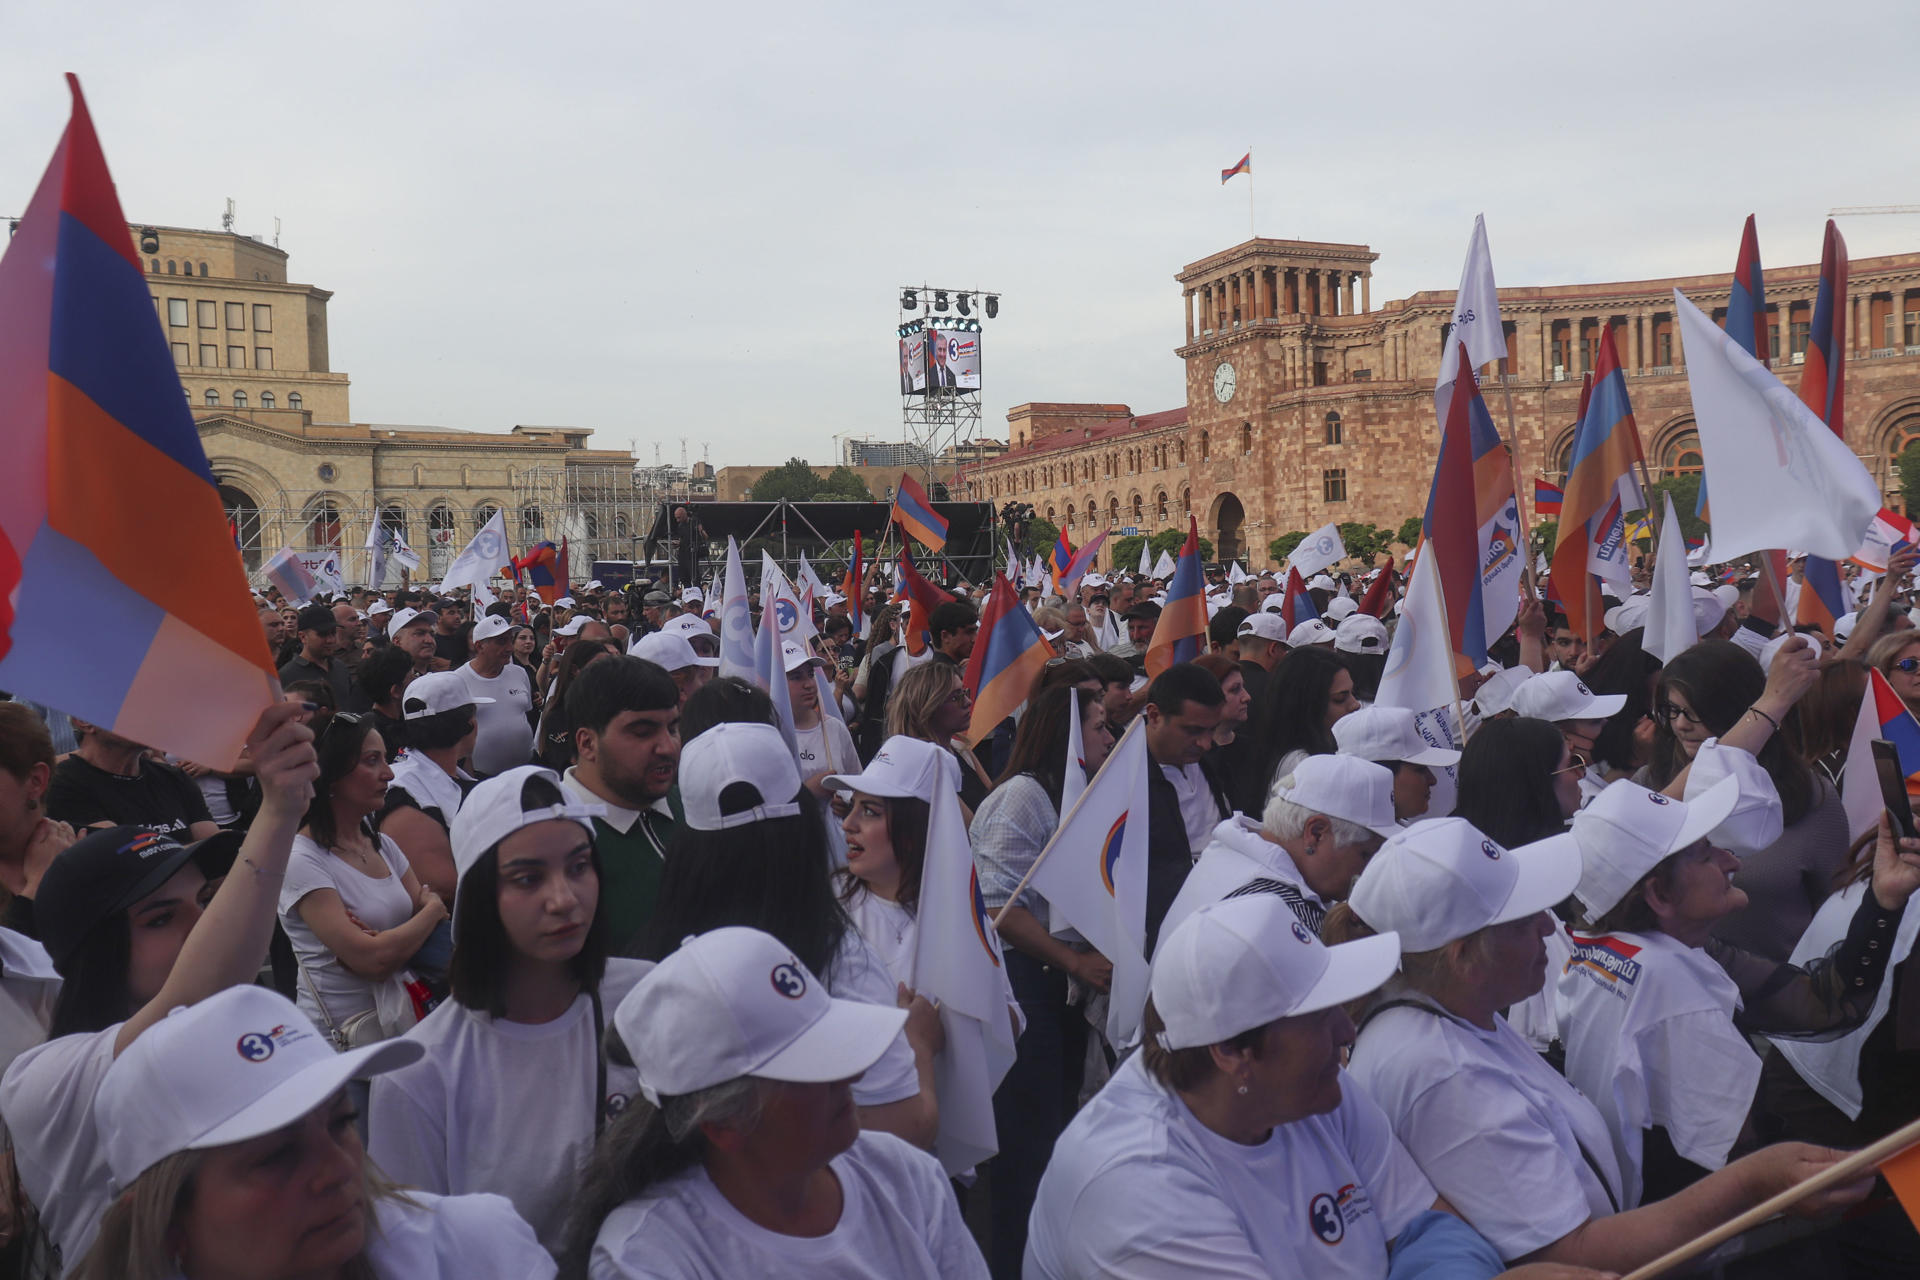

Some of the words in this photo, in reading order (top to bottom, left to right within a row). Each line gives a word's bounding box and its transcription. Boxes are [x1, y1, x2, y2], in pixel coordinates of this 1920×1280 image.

[800, 750, 815, 760] alo
[774, 966, 804, 996] 3
[243, 1035, 271, 1060] 3
[1314, 1196, 1342, 1242] 3
